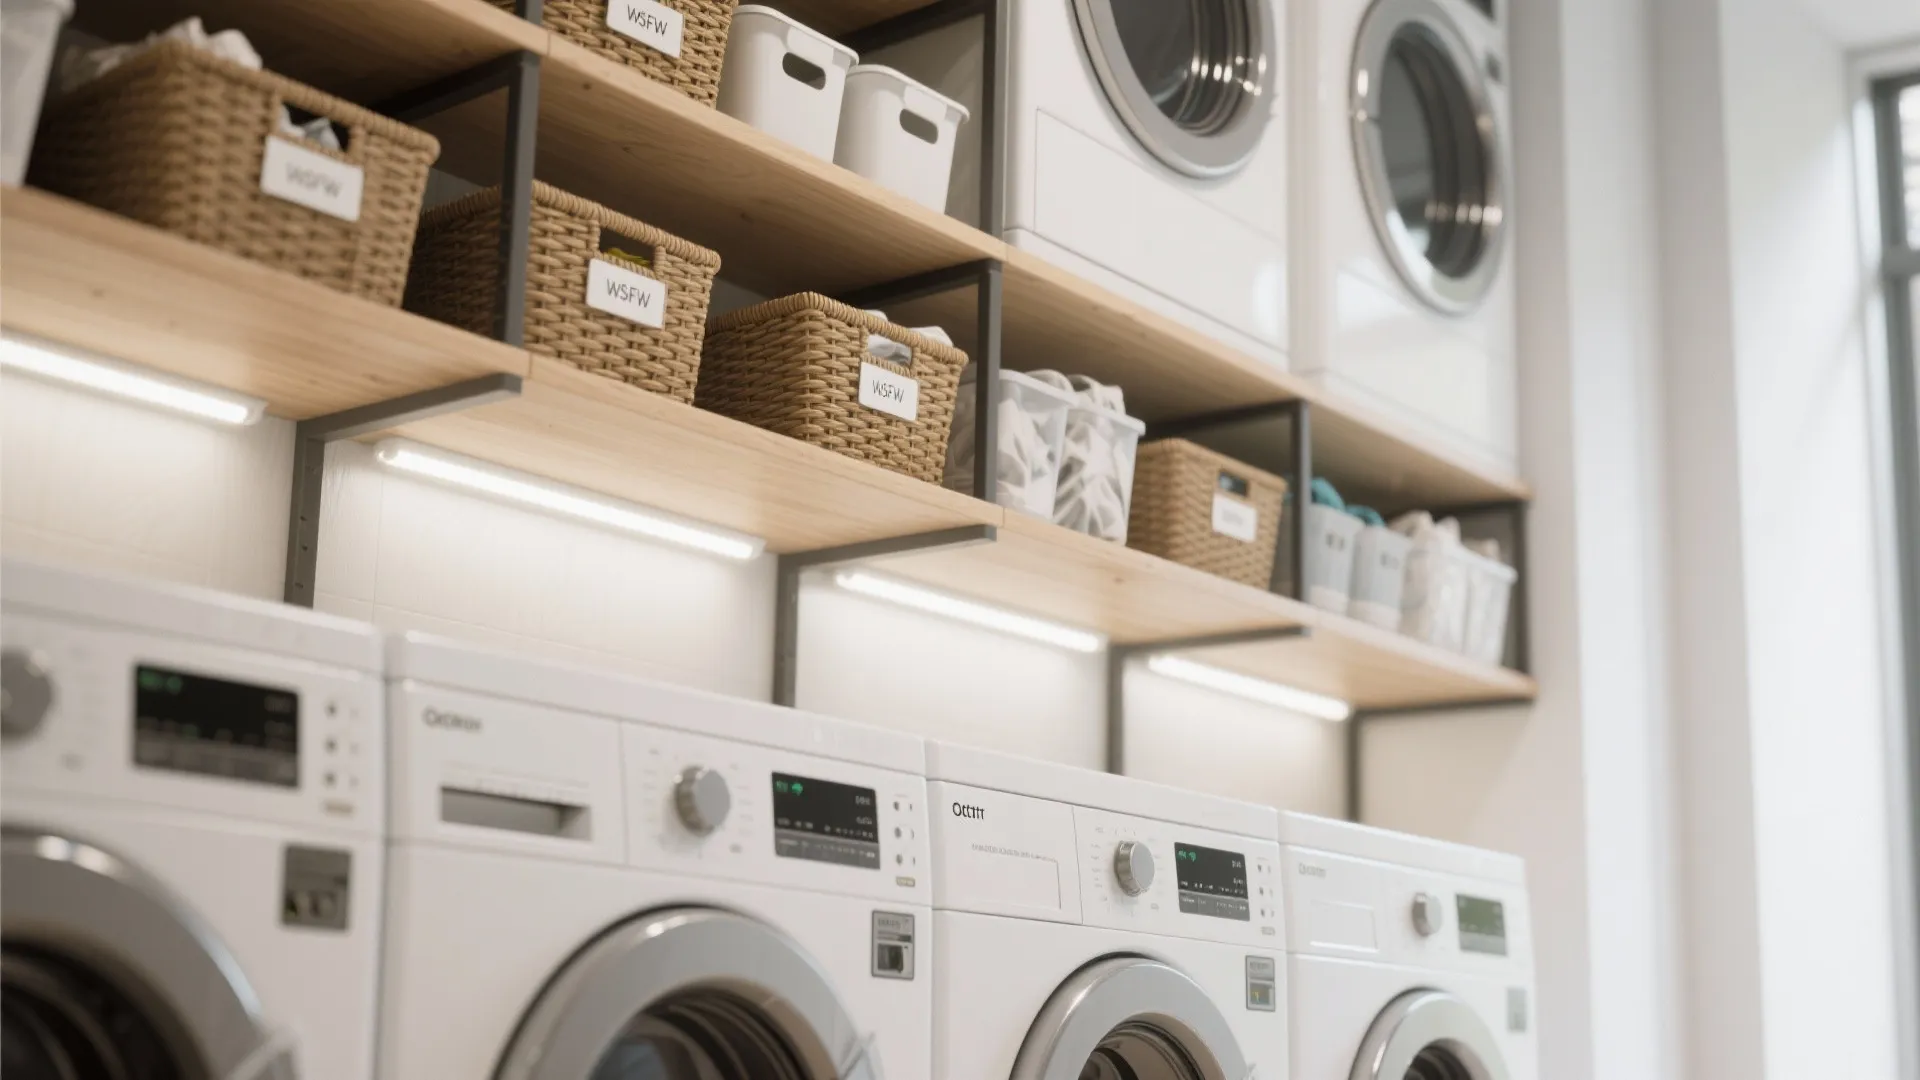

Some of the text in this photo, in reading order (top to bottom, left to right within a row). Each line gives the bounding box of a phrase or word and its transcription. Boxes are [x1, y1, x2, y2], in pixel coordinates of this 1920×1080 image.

[627, 4, 667, 36] WSFW
[606, 278, 650, 308] WSFW
[872, 379, 904, 403] WSFW
